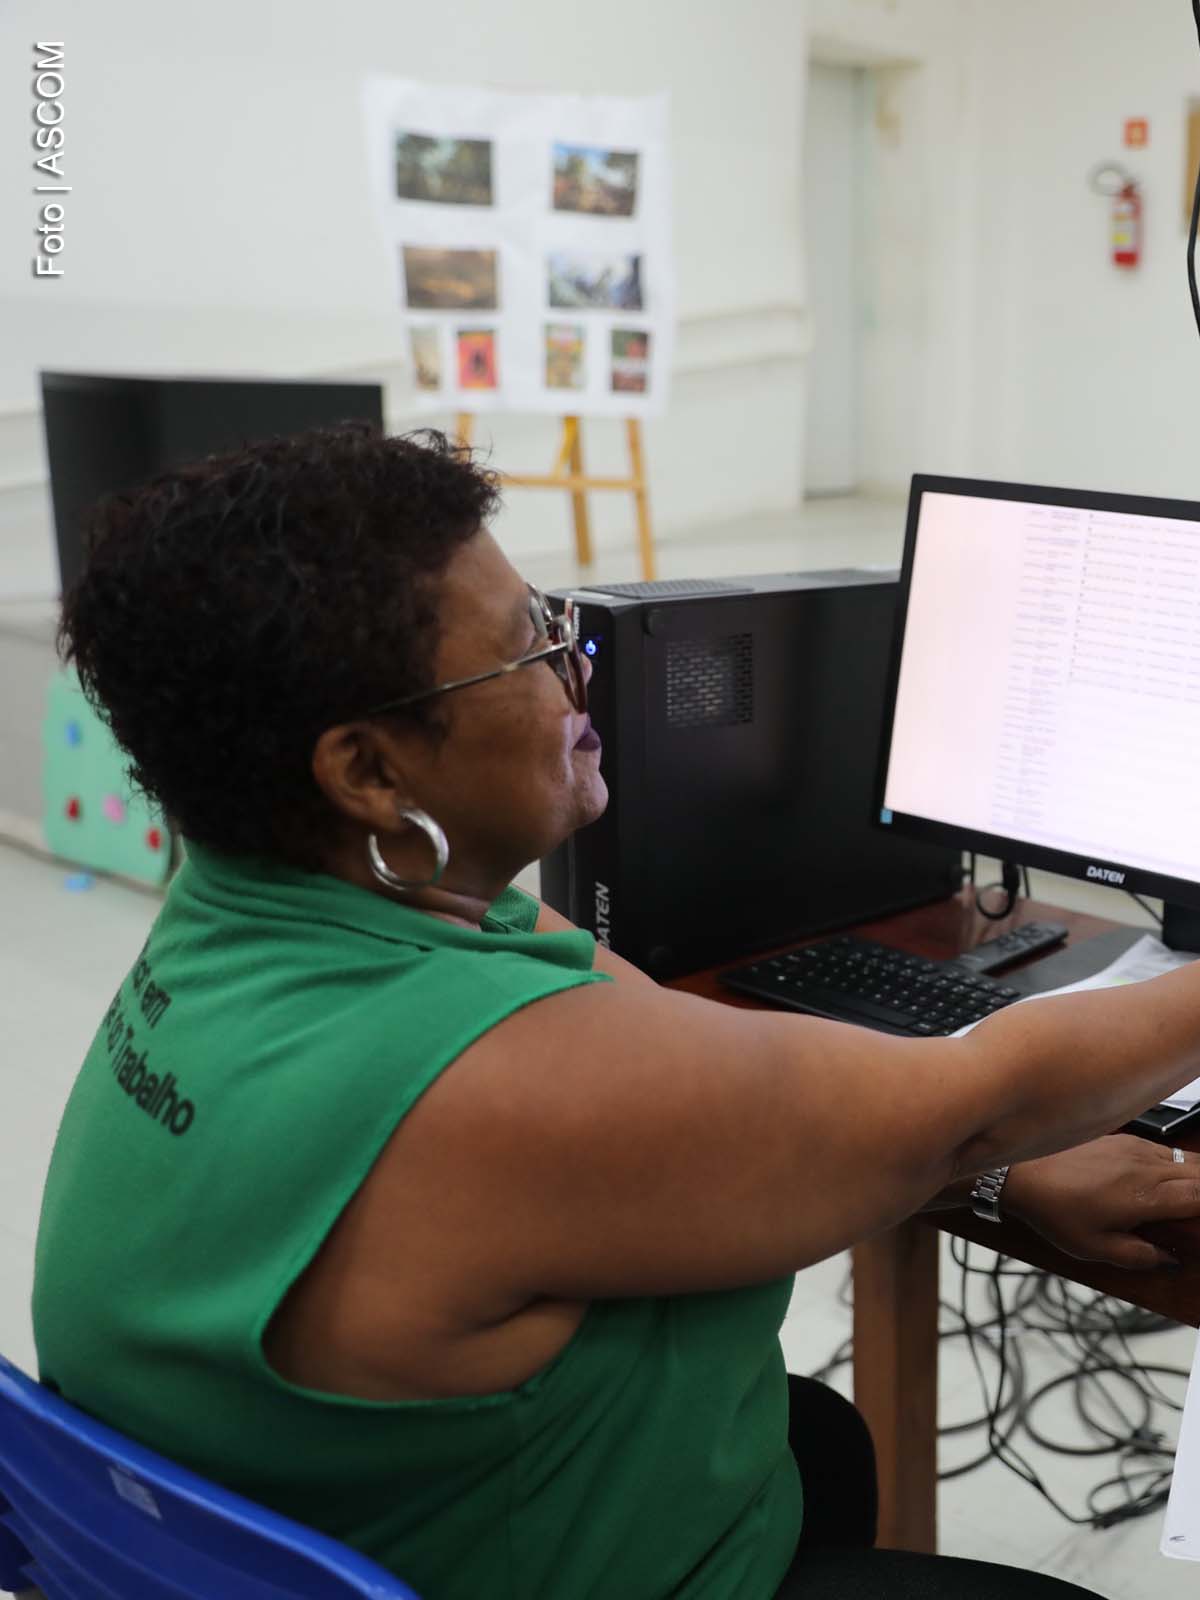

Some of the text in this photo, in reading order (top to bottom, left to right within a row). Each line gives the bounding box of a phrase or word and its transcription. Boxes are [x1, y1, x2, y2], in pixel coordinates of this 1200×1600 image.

[1086, 865, 1126, 884] DATEN
[595, 881, 610, 949] ATEN
[112, 1024, 195, 1137] Trabalho
